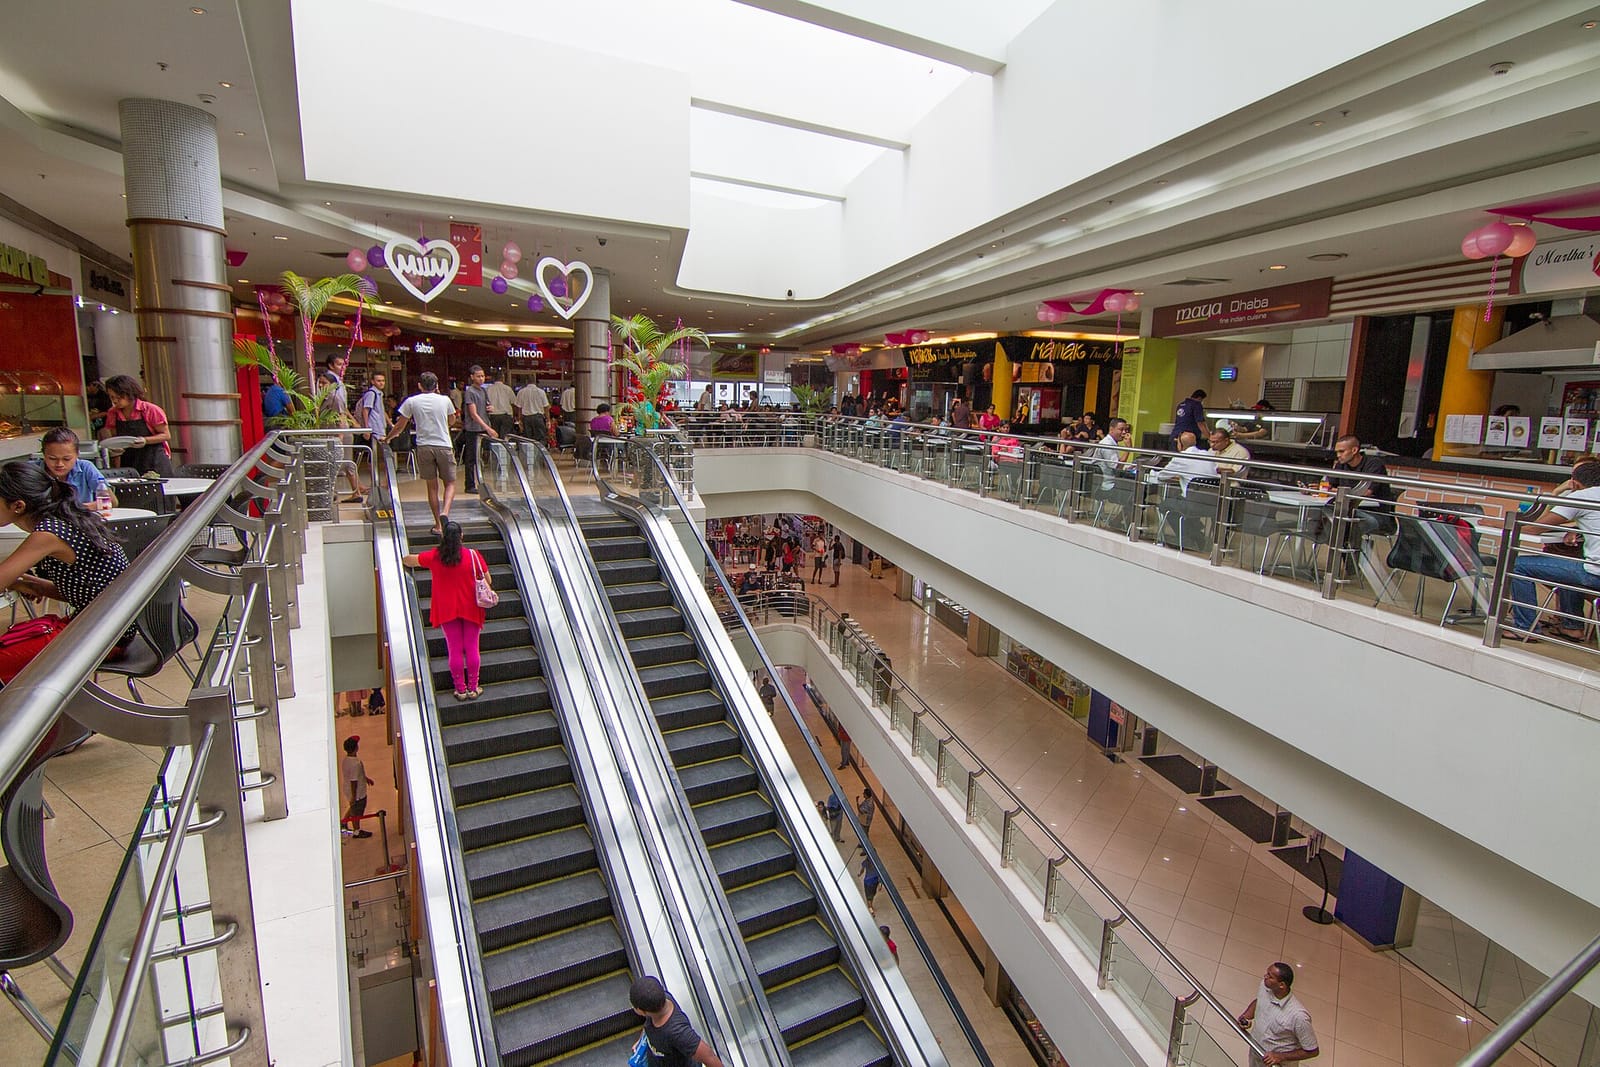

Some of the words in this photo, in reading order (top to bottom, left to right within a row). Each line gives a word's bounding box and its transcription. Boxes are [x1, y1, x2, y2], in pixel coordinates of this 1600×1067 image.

[1535, 244, 1593, 266] Martha's
[1176, 302, 1222, 321] maya
[1230, 297, 1269, 313] Dhaba
[507, 347, 543, 359] daltron
[1089, 346, 1112, 363] Truly
